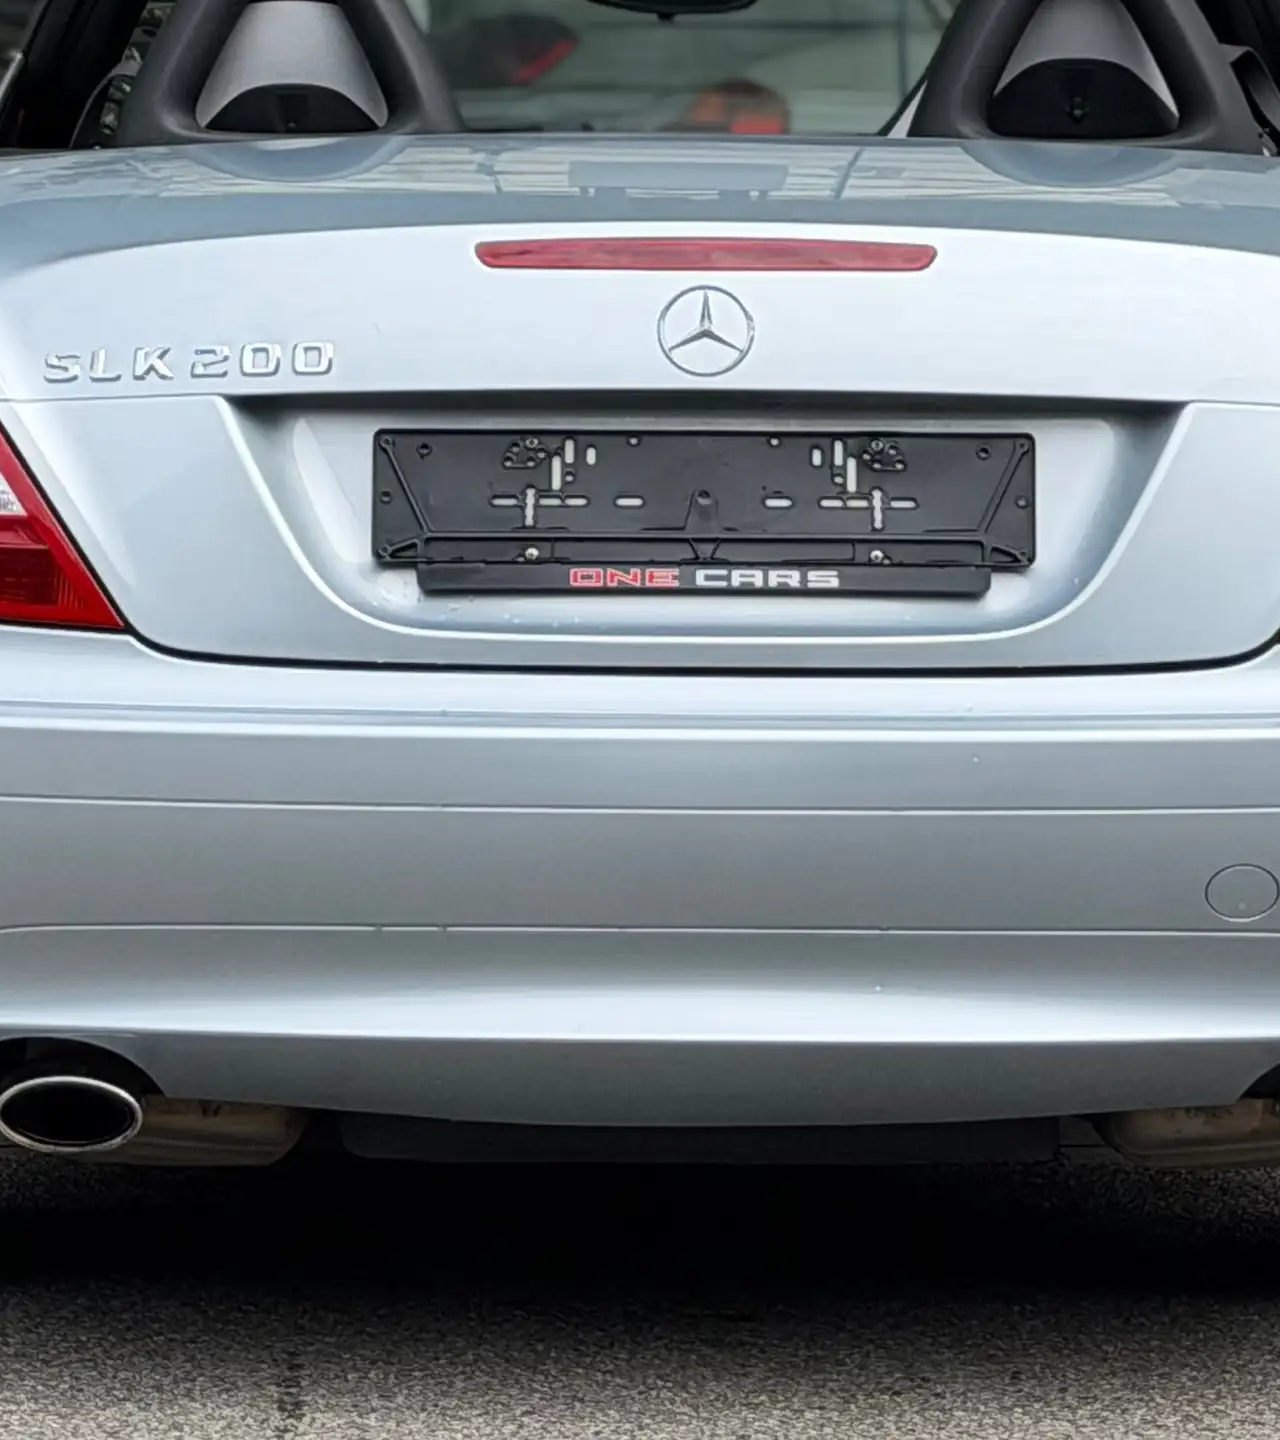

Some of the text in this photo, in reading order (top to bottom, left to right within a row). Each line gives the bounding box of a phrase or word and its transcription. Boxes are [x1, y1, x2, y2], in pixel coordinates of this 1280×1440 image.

[43, 340, 335, 383] SLK 200
[569, 566, 840, 589] ONE CARS
